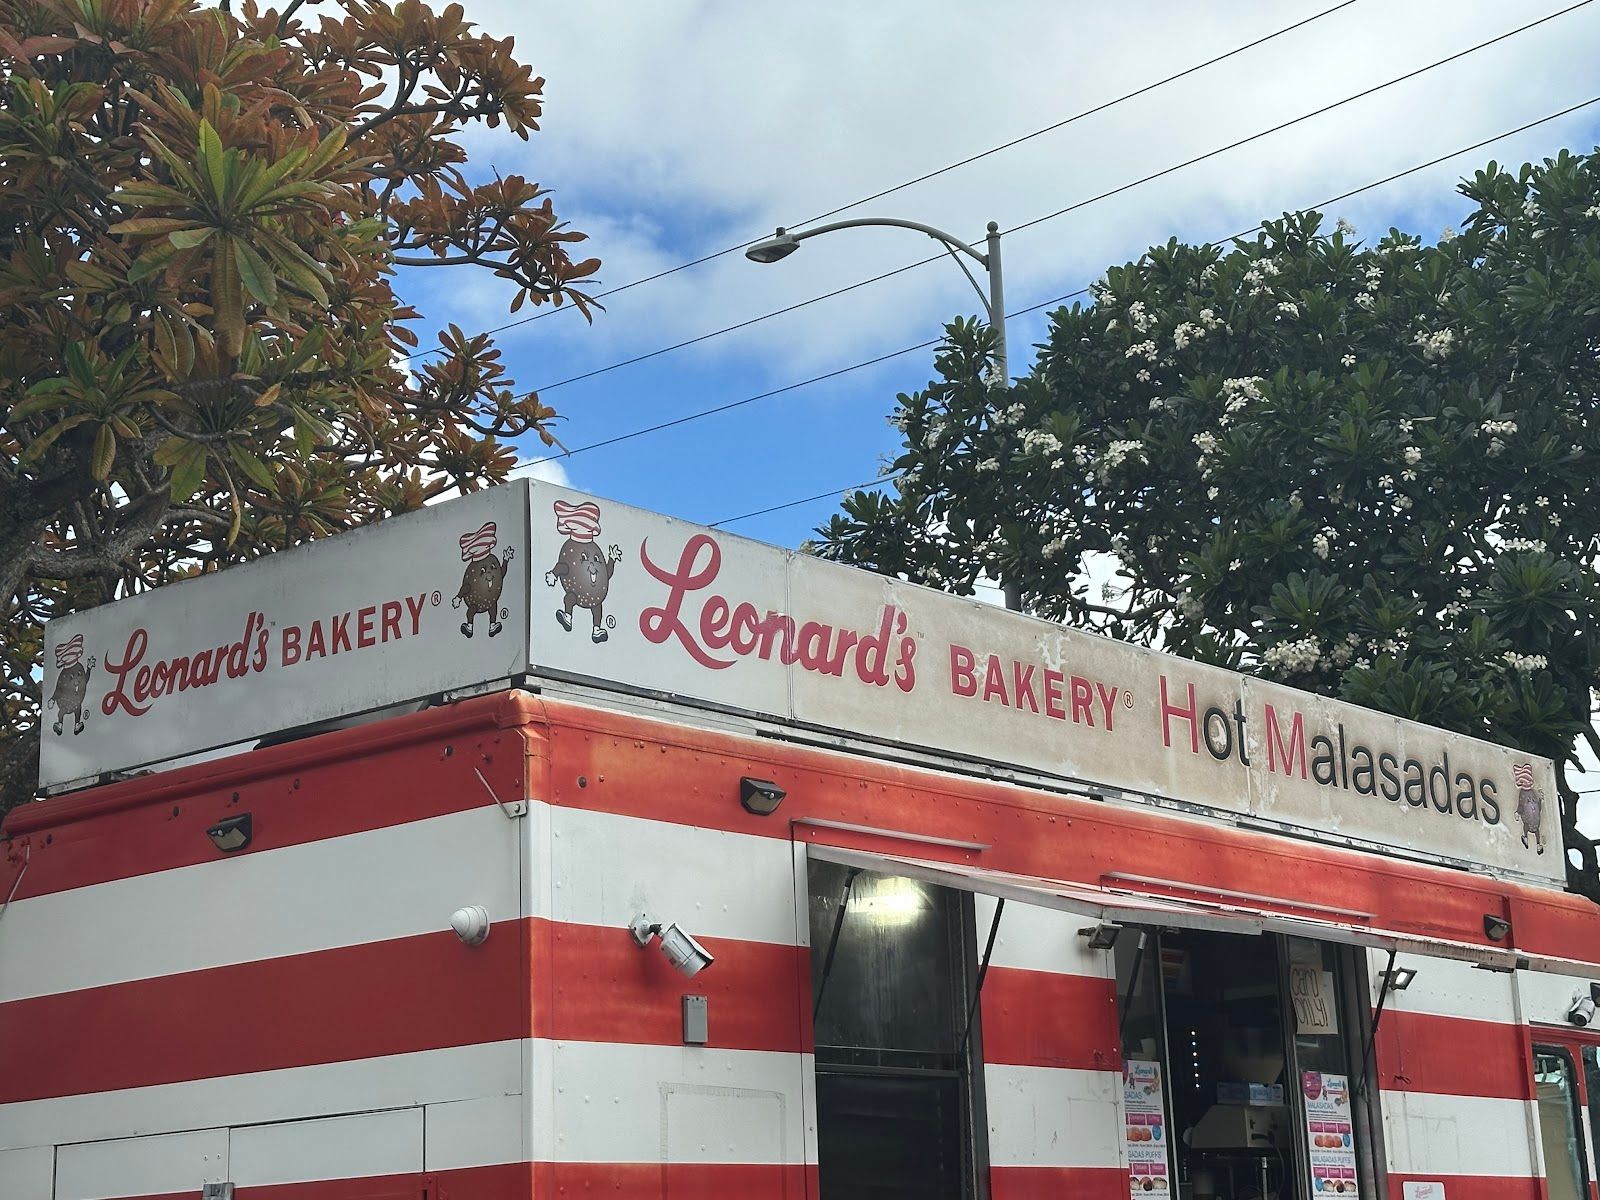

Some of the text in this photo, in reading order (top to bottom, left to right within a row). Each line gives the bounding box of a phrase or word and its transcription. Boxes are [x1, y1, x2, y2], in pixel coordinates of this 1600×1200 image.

[101, 611, 269, 716] Leonard's
[641, 533, 917, 692] Leonard's
[1159, 675, 1250, 767] Hot
[1264, 704, 1501, 825] Malasadas
